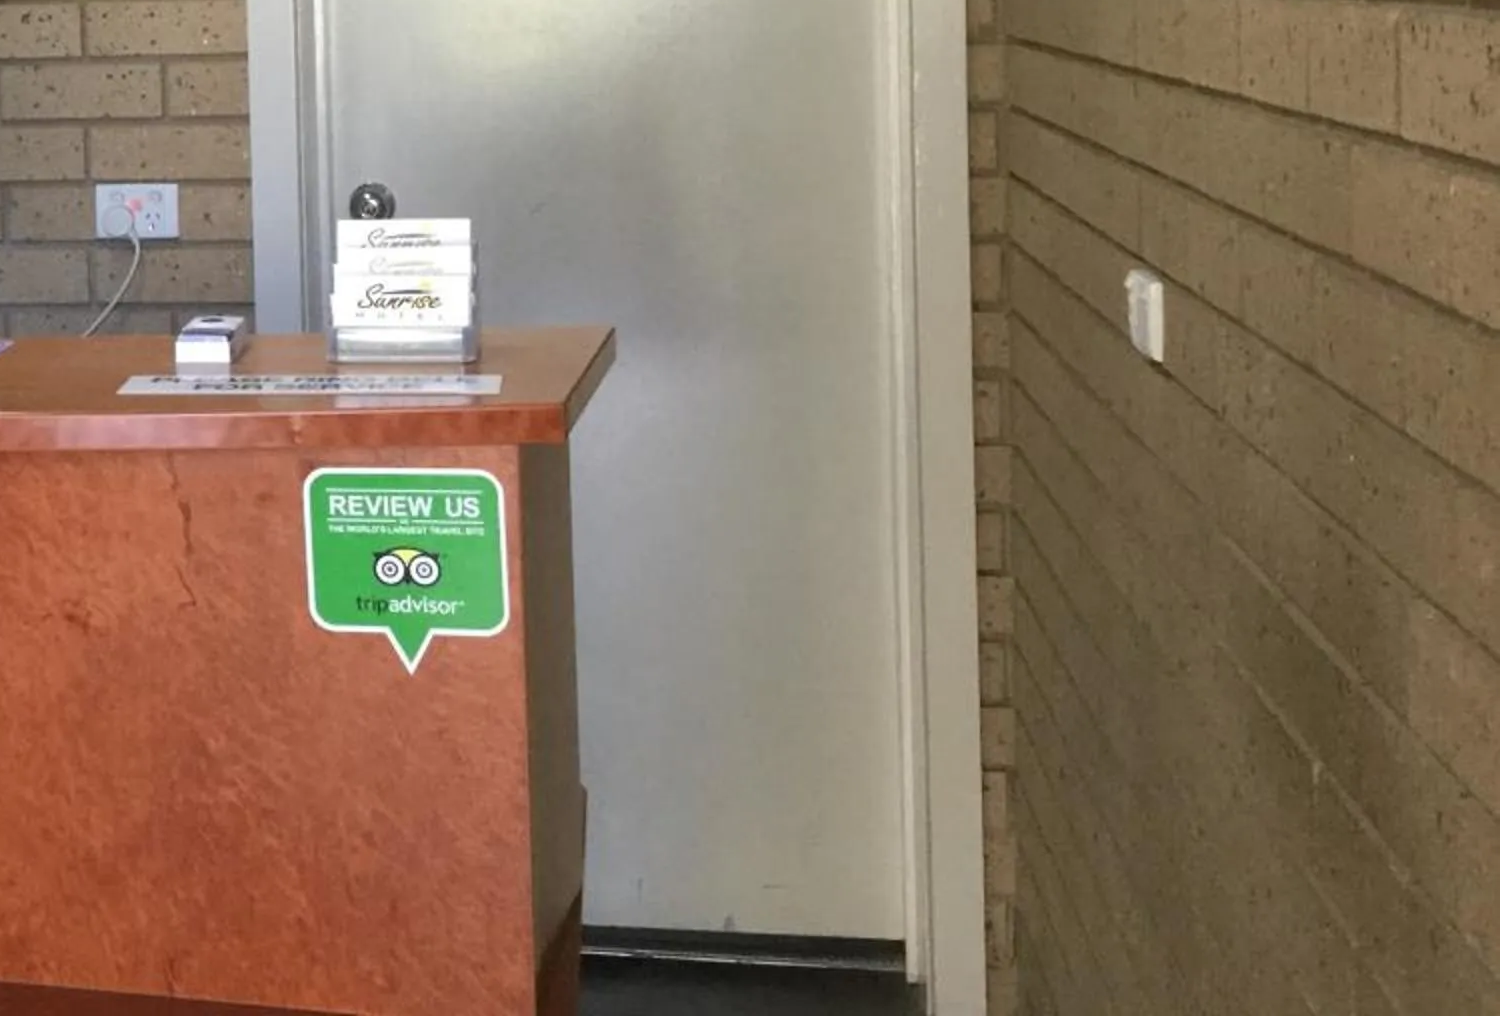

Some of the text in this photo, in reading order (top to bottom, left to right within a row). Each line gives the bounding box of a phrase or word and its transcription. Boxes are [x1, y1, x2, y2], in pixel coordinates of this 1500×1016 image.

[357, 283, 443, 309] Sunrise
[329, 495, 481, 518] REVIEW US
[356, 596, 460, 617] tripadvisor
